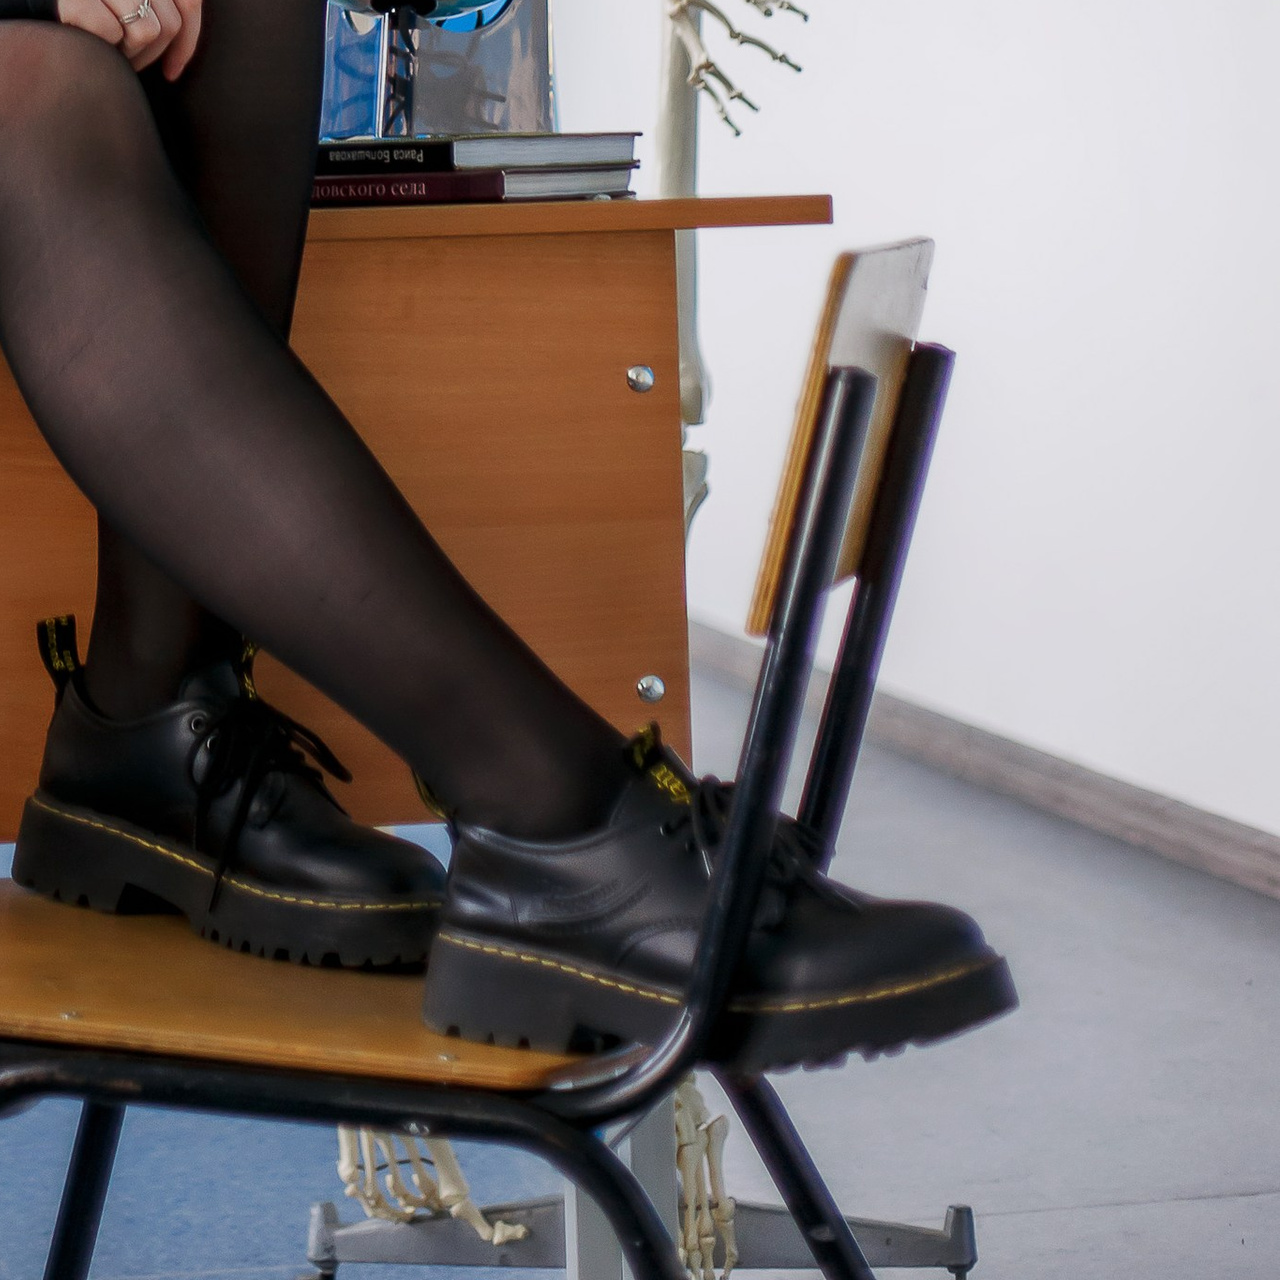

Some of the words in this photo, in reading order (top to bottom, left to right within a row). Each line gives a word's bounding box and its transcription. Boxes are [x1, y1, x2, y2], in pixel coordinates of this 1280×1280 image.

[329, 149, 391, 163] Большакова
[393, 149, 424, 163] Раиса
[391, 182, 426, 196] села
